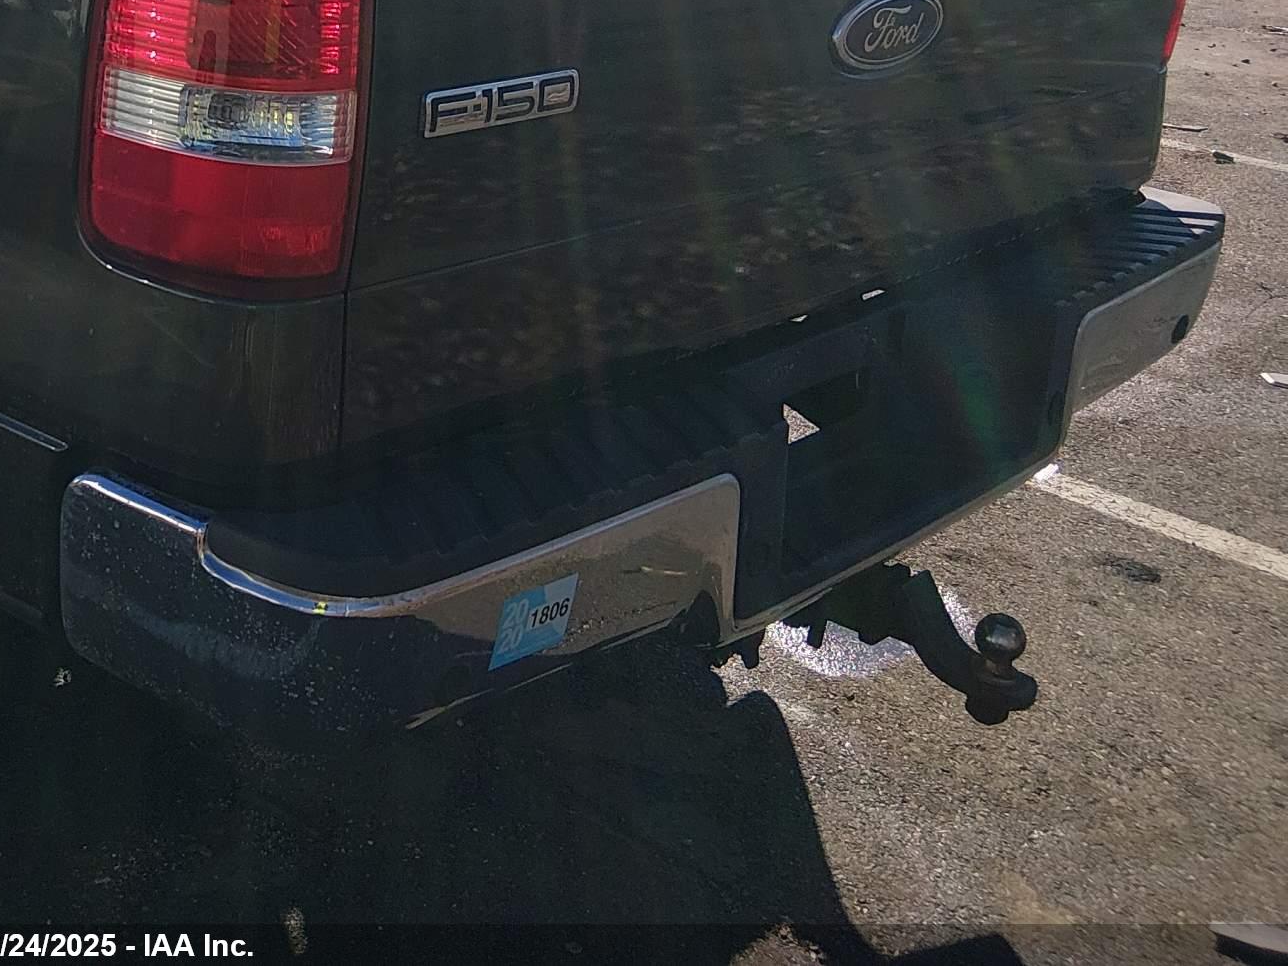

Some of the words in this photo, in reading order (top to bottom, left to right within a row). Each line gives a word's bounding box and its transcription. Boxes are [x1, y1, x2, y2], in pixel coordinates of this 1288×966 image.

[864, 5, 925, 52] Ford
[428, 74, 577, 133] F-150
[530, 597, 571, 628] 1806
